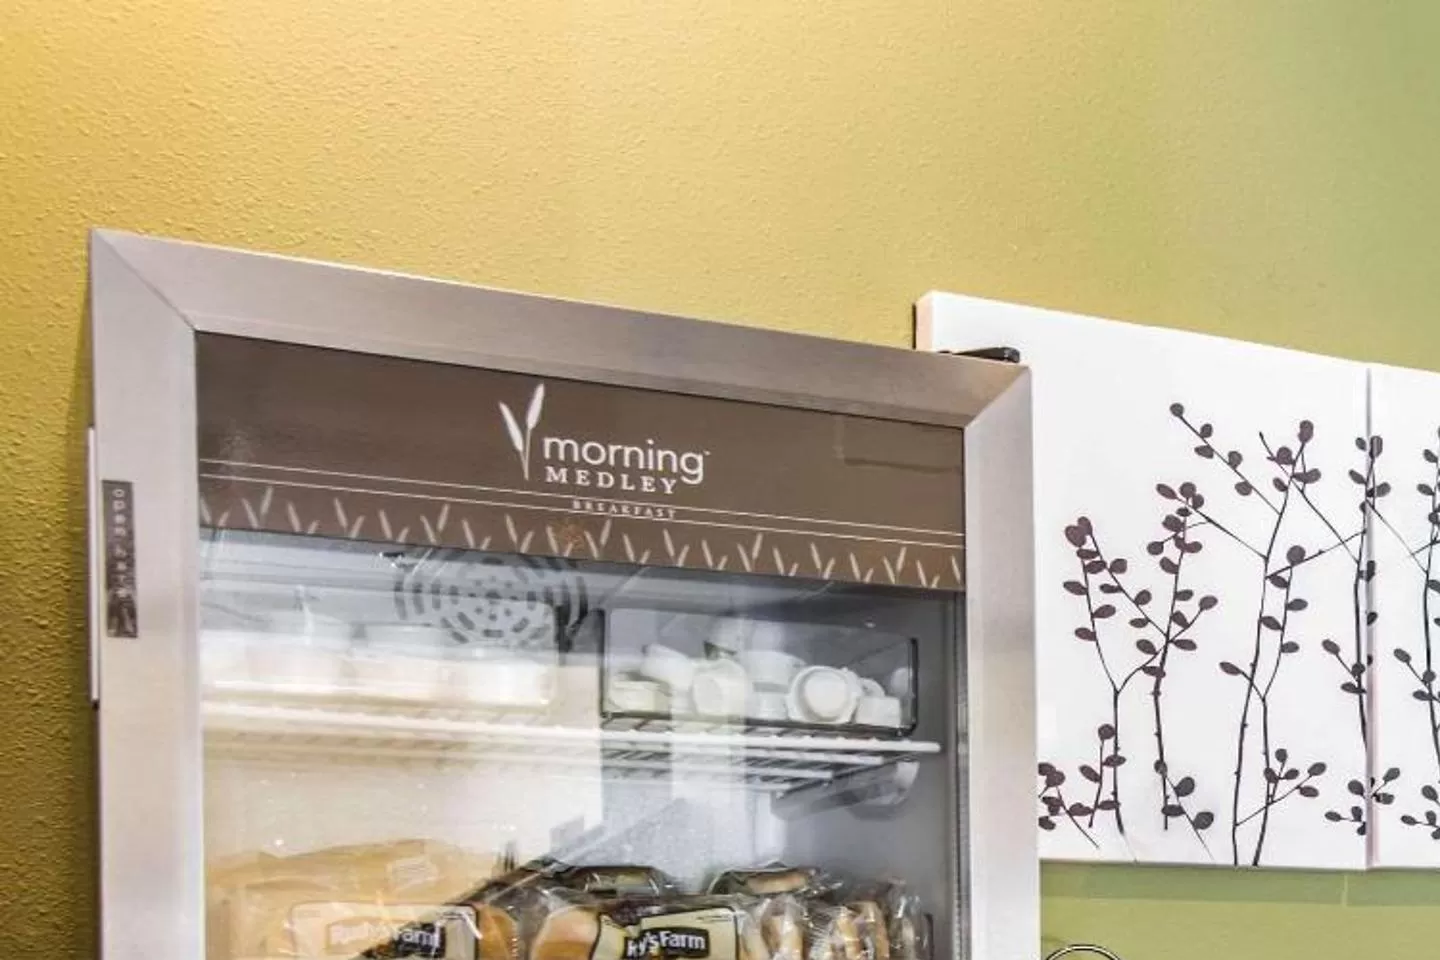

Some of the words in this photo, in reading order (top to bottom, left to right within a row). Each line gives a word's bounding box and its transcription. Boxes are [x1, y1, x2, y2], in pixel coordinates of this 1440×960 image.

[543, 436, 705, 485] morning
[545, 466, 677, 495] MEDLEY
[573, 499, 677, 519] BREAKFAST
[660, 931, 706, 949] Farm
